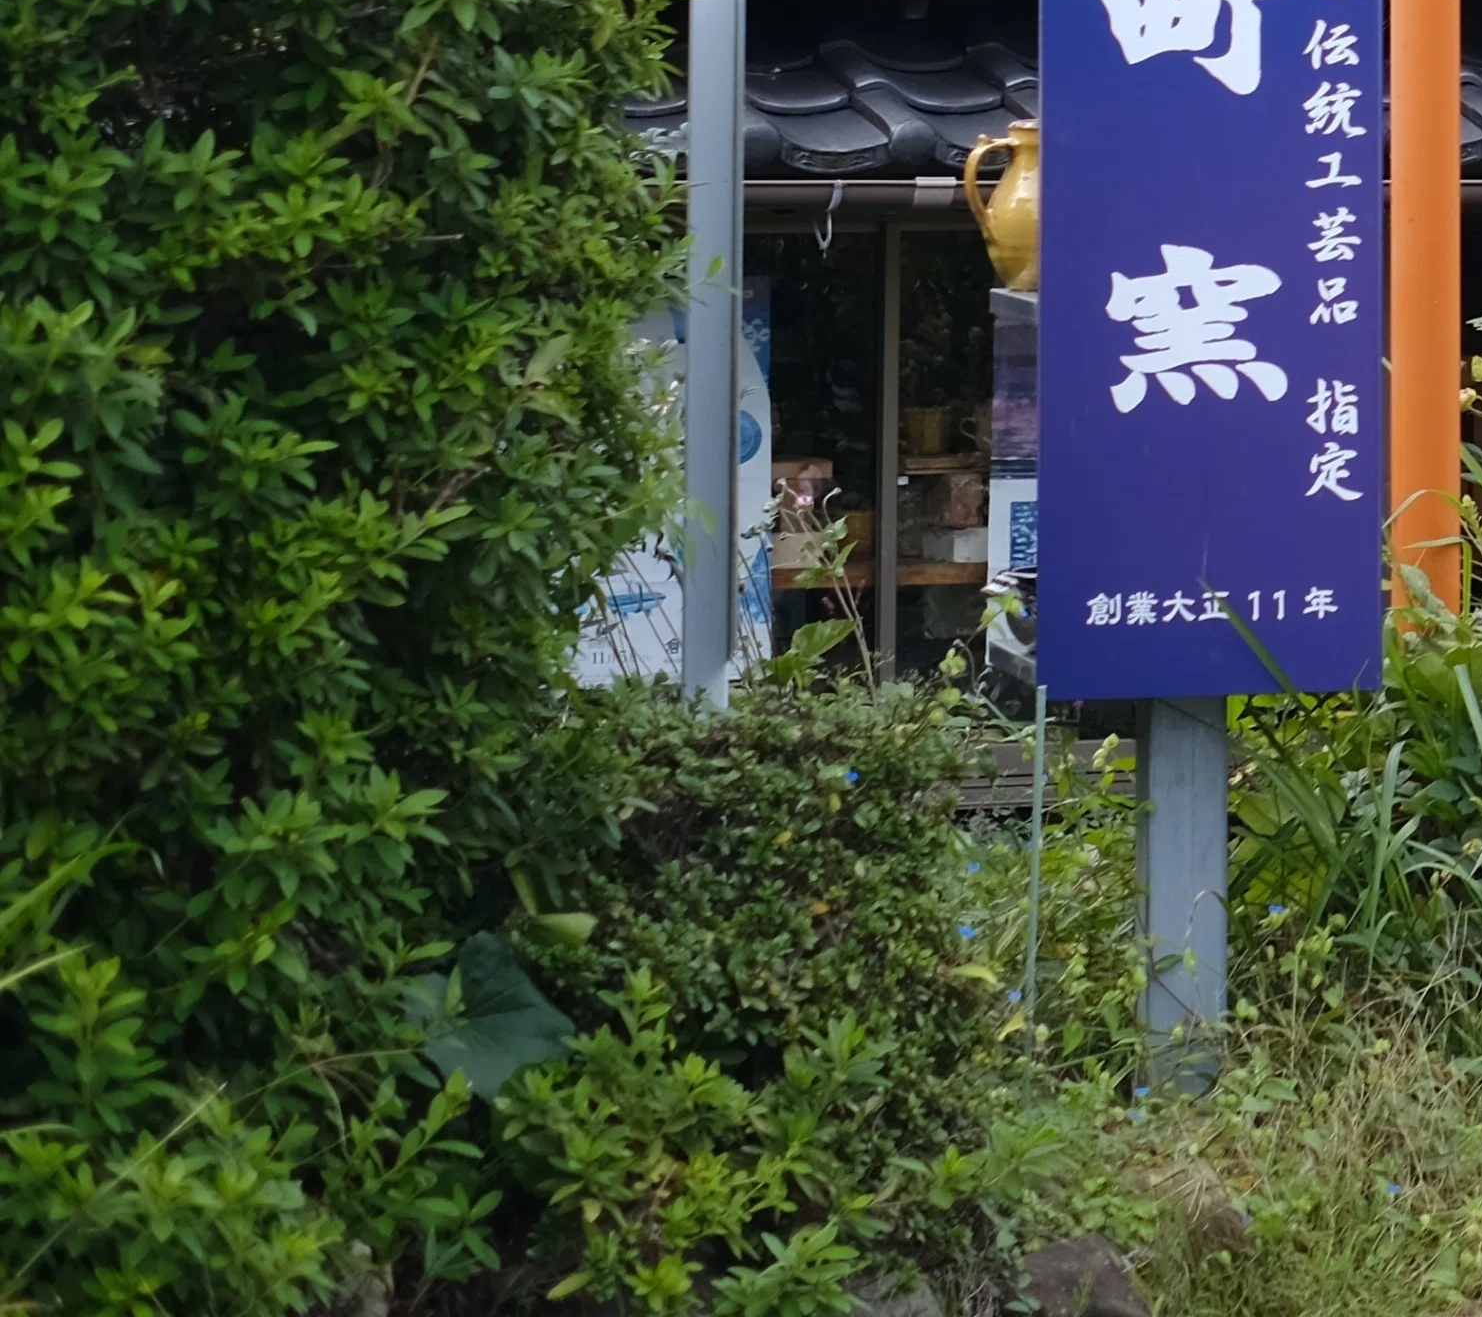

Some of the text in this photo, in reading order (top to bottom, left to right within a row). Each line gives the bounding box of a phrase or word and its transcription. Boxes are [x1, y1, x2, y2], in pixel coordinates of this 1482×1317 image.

[1304, 378, 1363, 501] 指定
[1086, 586, 1339, 626] 創業大正11年
